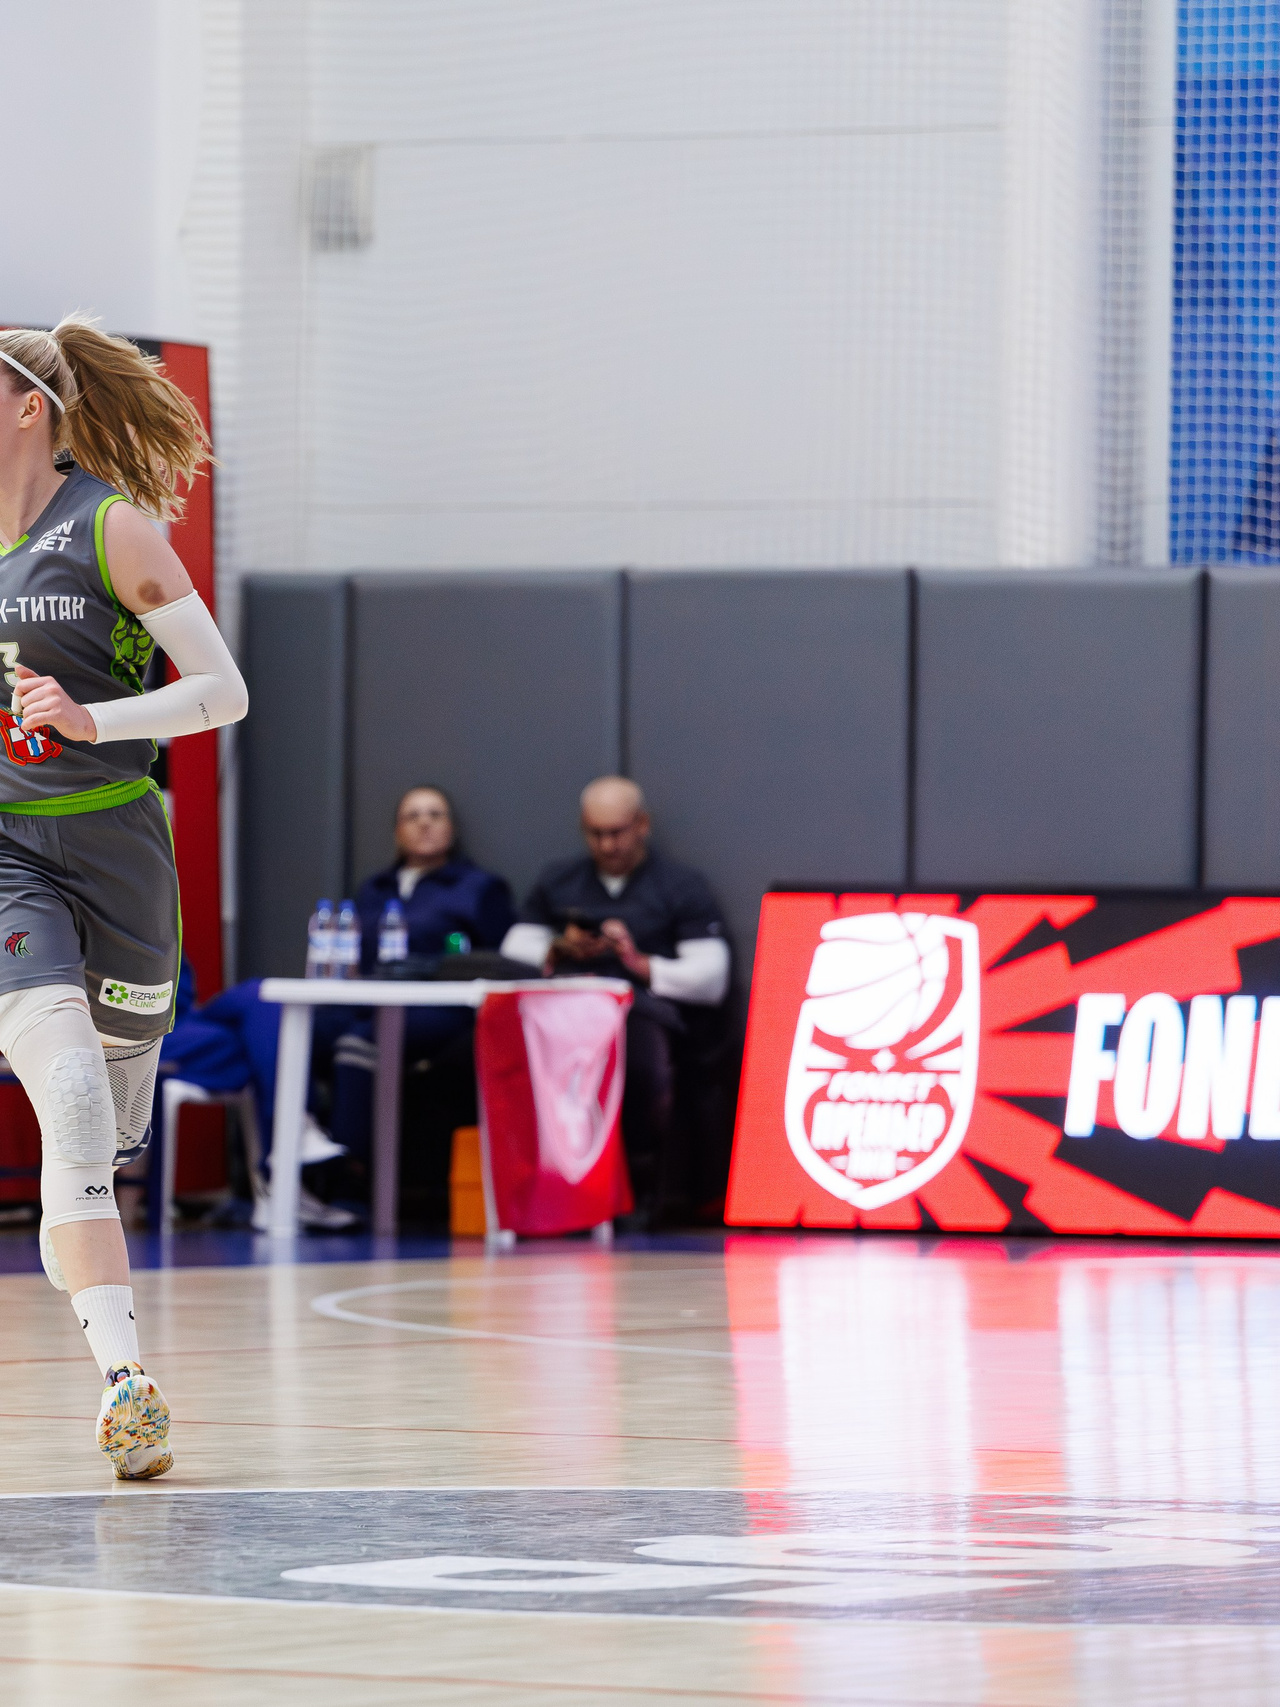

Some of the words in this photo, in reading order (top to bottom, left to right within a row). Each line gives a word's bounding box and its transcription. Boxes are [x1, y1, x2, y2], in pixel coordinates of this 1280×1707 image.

[29, 536, 72, 553] BET
[130, 988, 170, 1001] EZRAMED
[129, 999, 157, 1008] CLINIC
